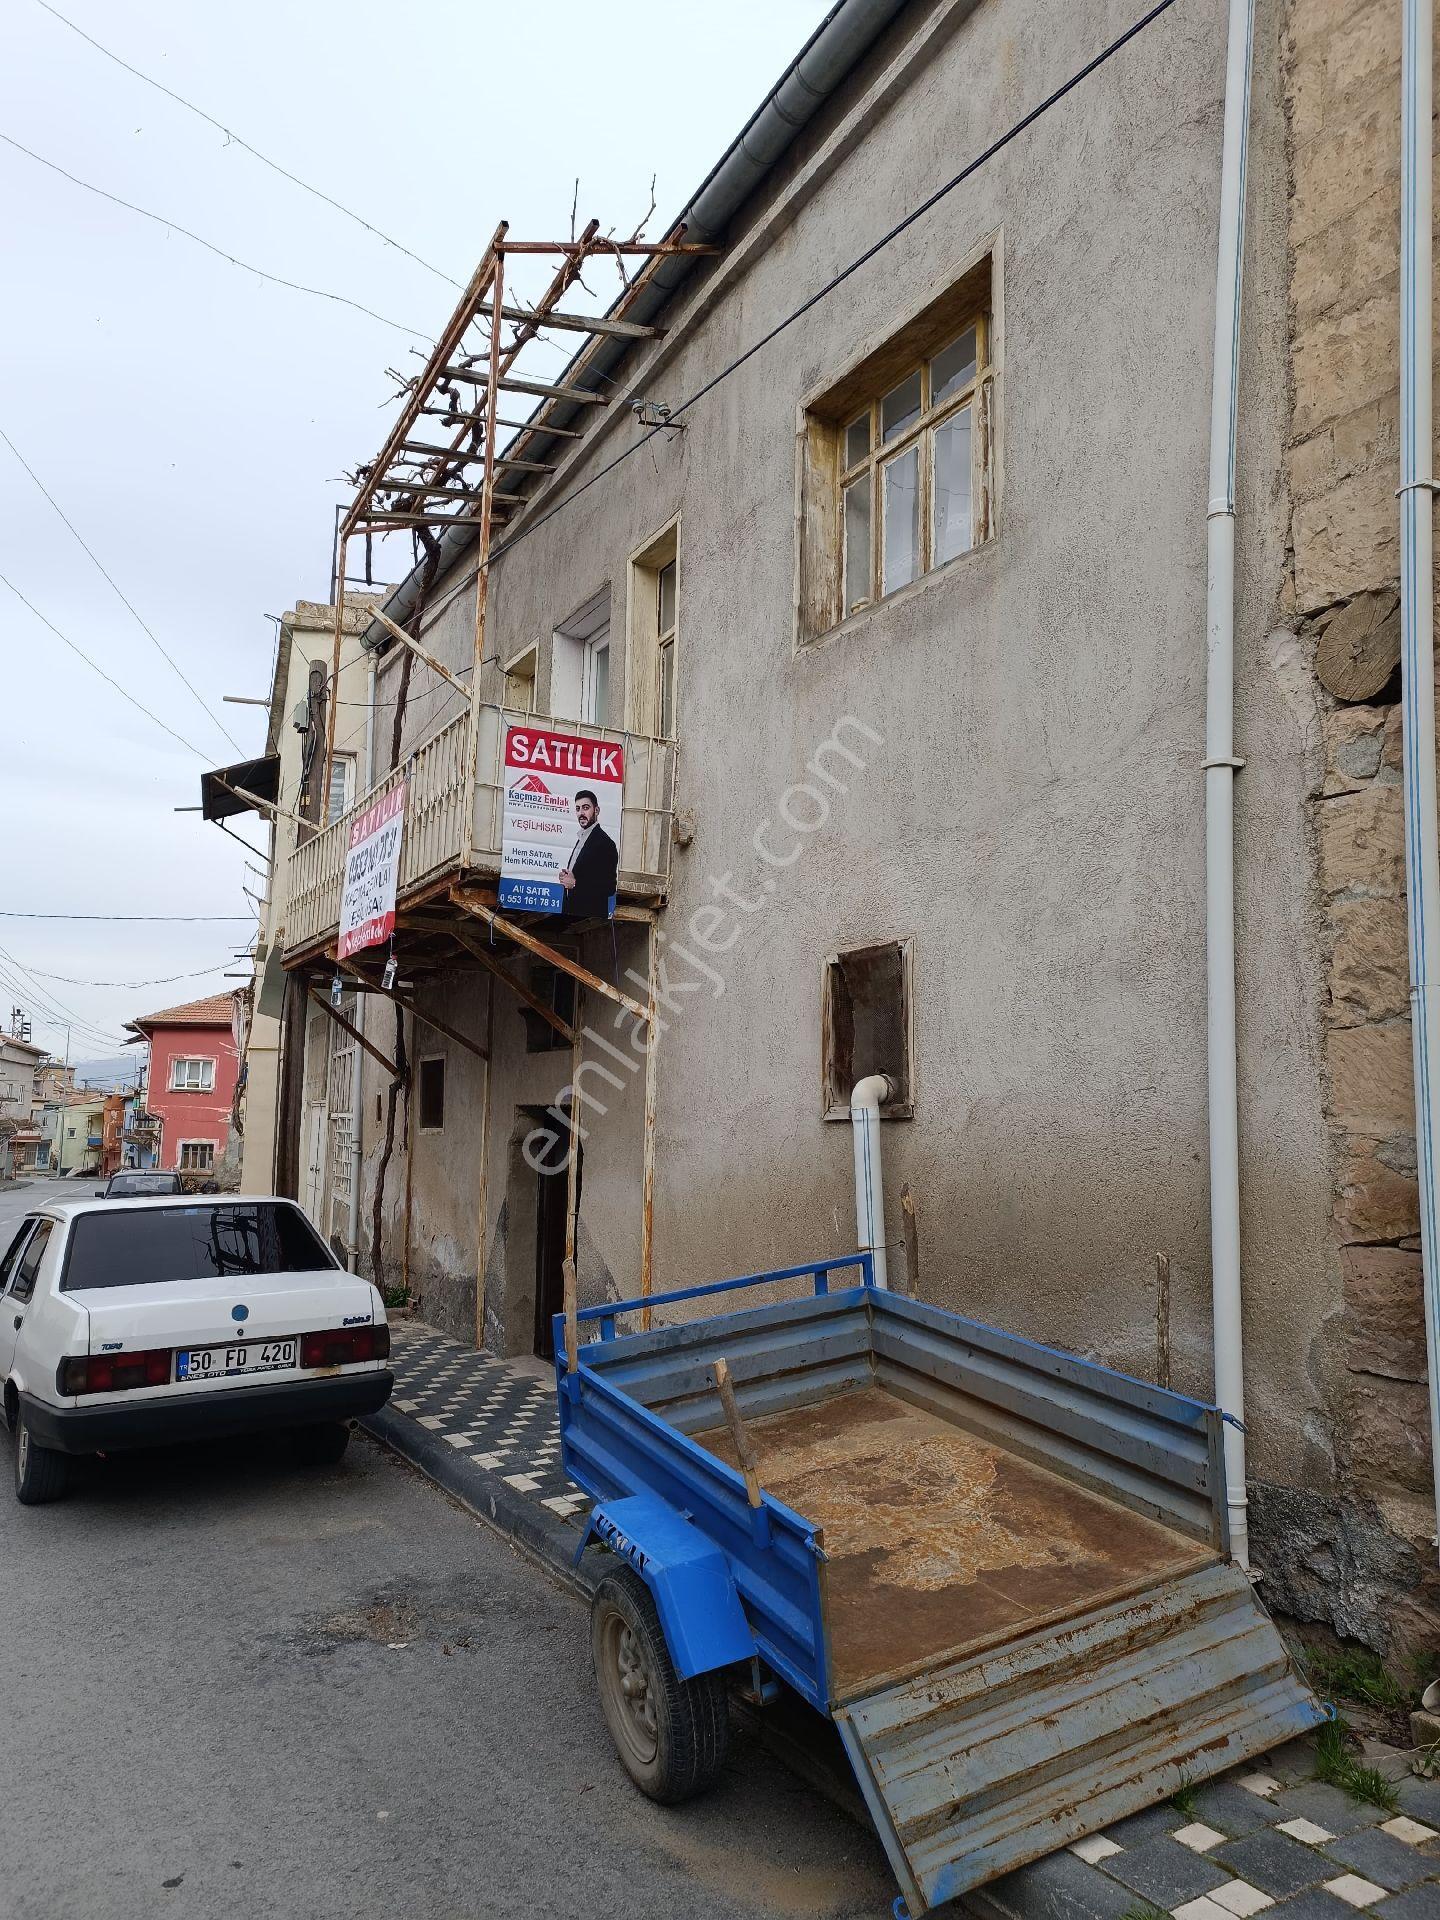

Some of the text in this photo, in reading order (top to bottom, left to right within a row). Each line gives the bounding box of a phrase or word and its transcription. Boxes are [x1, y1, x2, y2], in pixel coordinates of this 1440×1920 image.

[511, 734, 619, 777] SATILIK
[508, 789, 570, 807] Kaçmaz Emlak
[352, 784, 404, 846] SATILIK
[511, 818, 563, 834] YEŞİLHİSAR
[504, 856, 521, 865] Hem
[512, 847, 553, 860] Hem SATAR
[512, 885, 551, 897] Ali SATIR
[507, 894, 522, 904] 553
[524, 896, 537, 905] 161
[540, 898, 549, 907] 78
[551, 900, 560, 908] 31
[190, 1351, 212, 1372] 50
[225, 1348, 247, 1368] FD
[260, 1343, 292, 1363] 420
